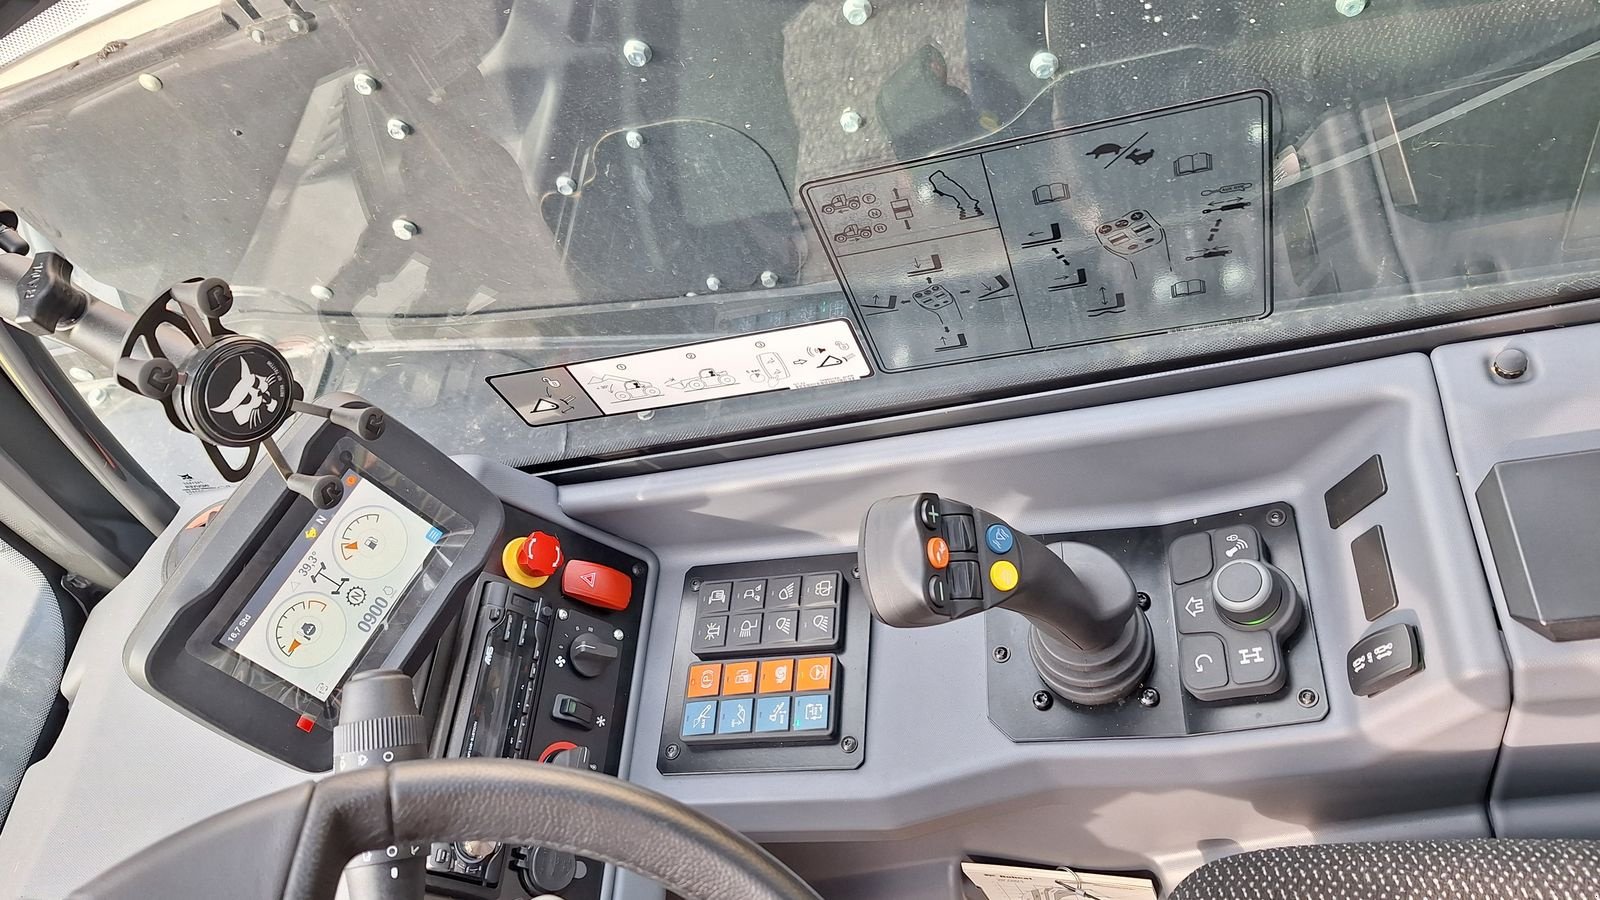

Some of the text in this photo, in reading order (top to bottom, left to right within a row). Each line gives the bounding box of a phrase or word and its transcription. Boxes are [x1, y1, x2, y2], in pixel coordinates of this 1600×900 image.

[315, 514, 327, 525] N
[350, 590, 363, 602] N
[357, 596, 388, 633] 0900
